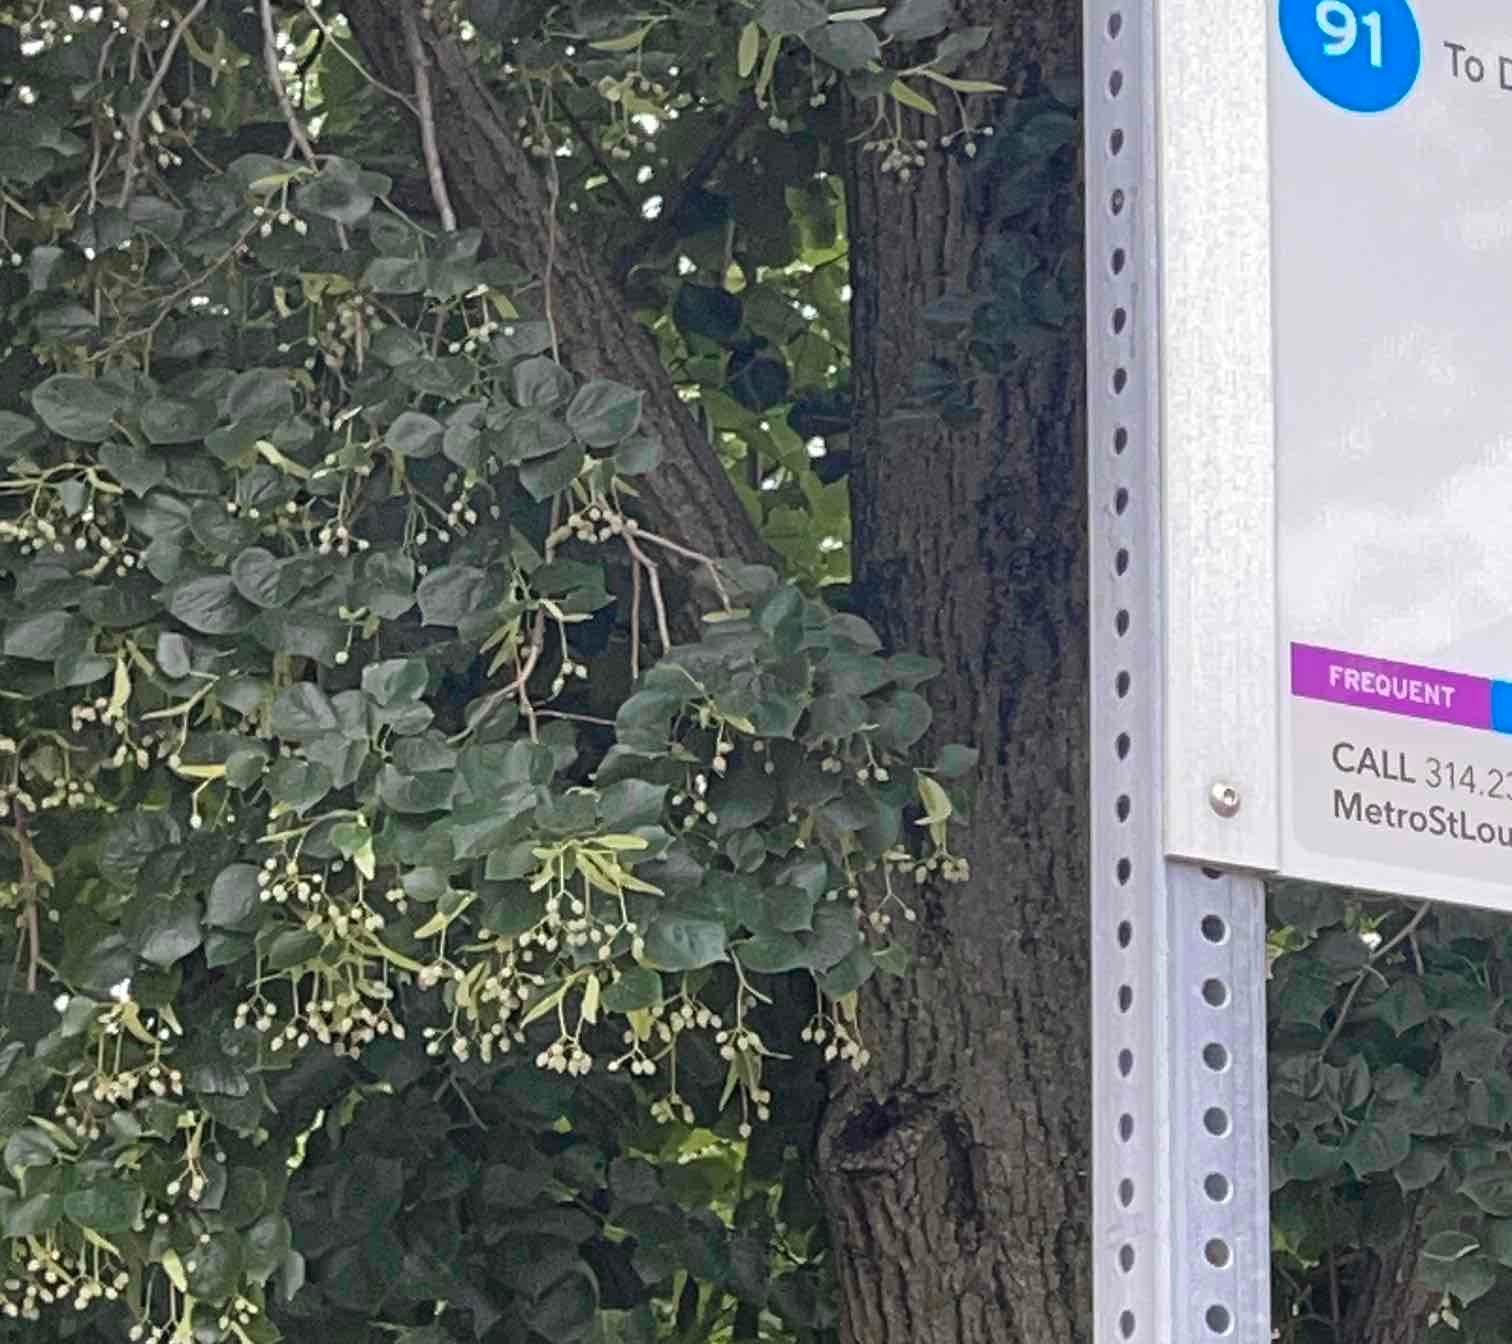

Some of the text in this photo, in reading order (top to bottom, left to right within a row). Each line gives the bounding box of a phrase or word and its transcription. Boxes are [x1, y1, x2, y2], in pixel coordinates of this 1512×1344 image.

[1314, 0, 1385, 67] 91
[1443, 41, 1485, 82] To
[1328, 664, 1456, 708] FREQUENT
[1331, 741, 1416, 784] CALL
